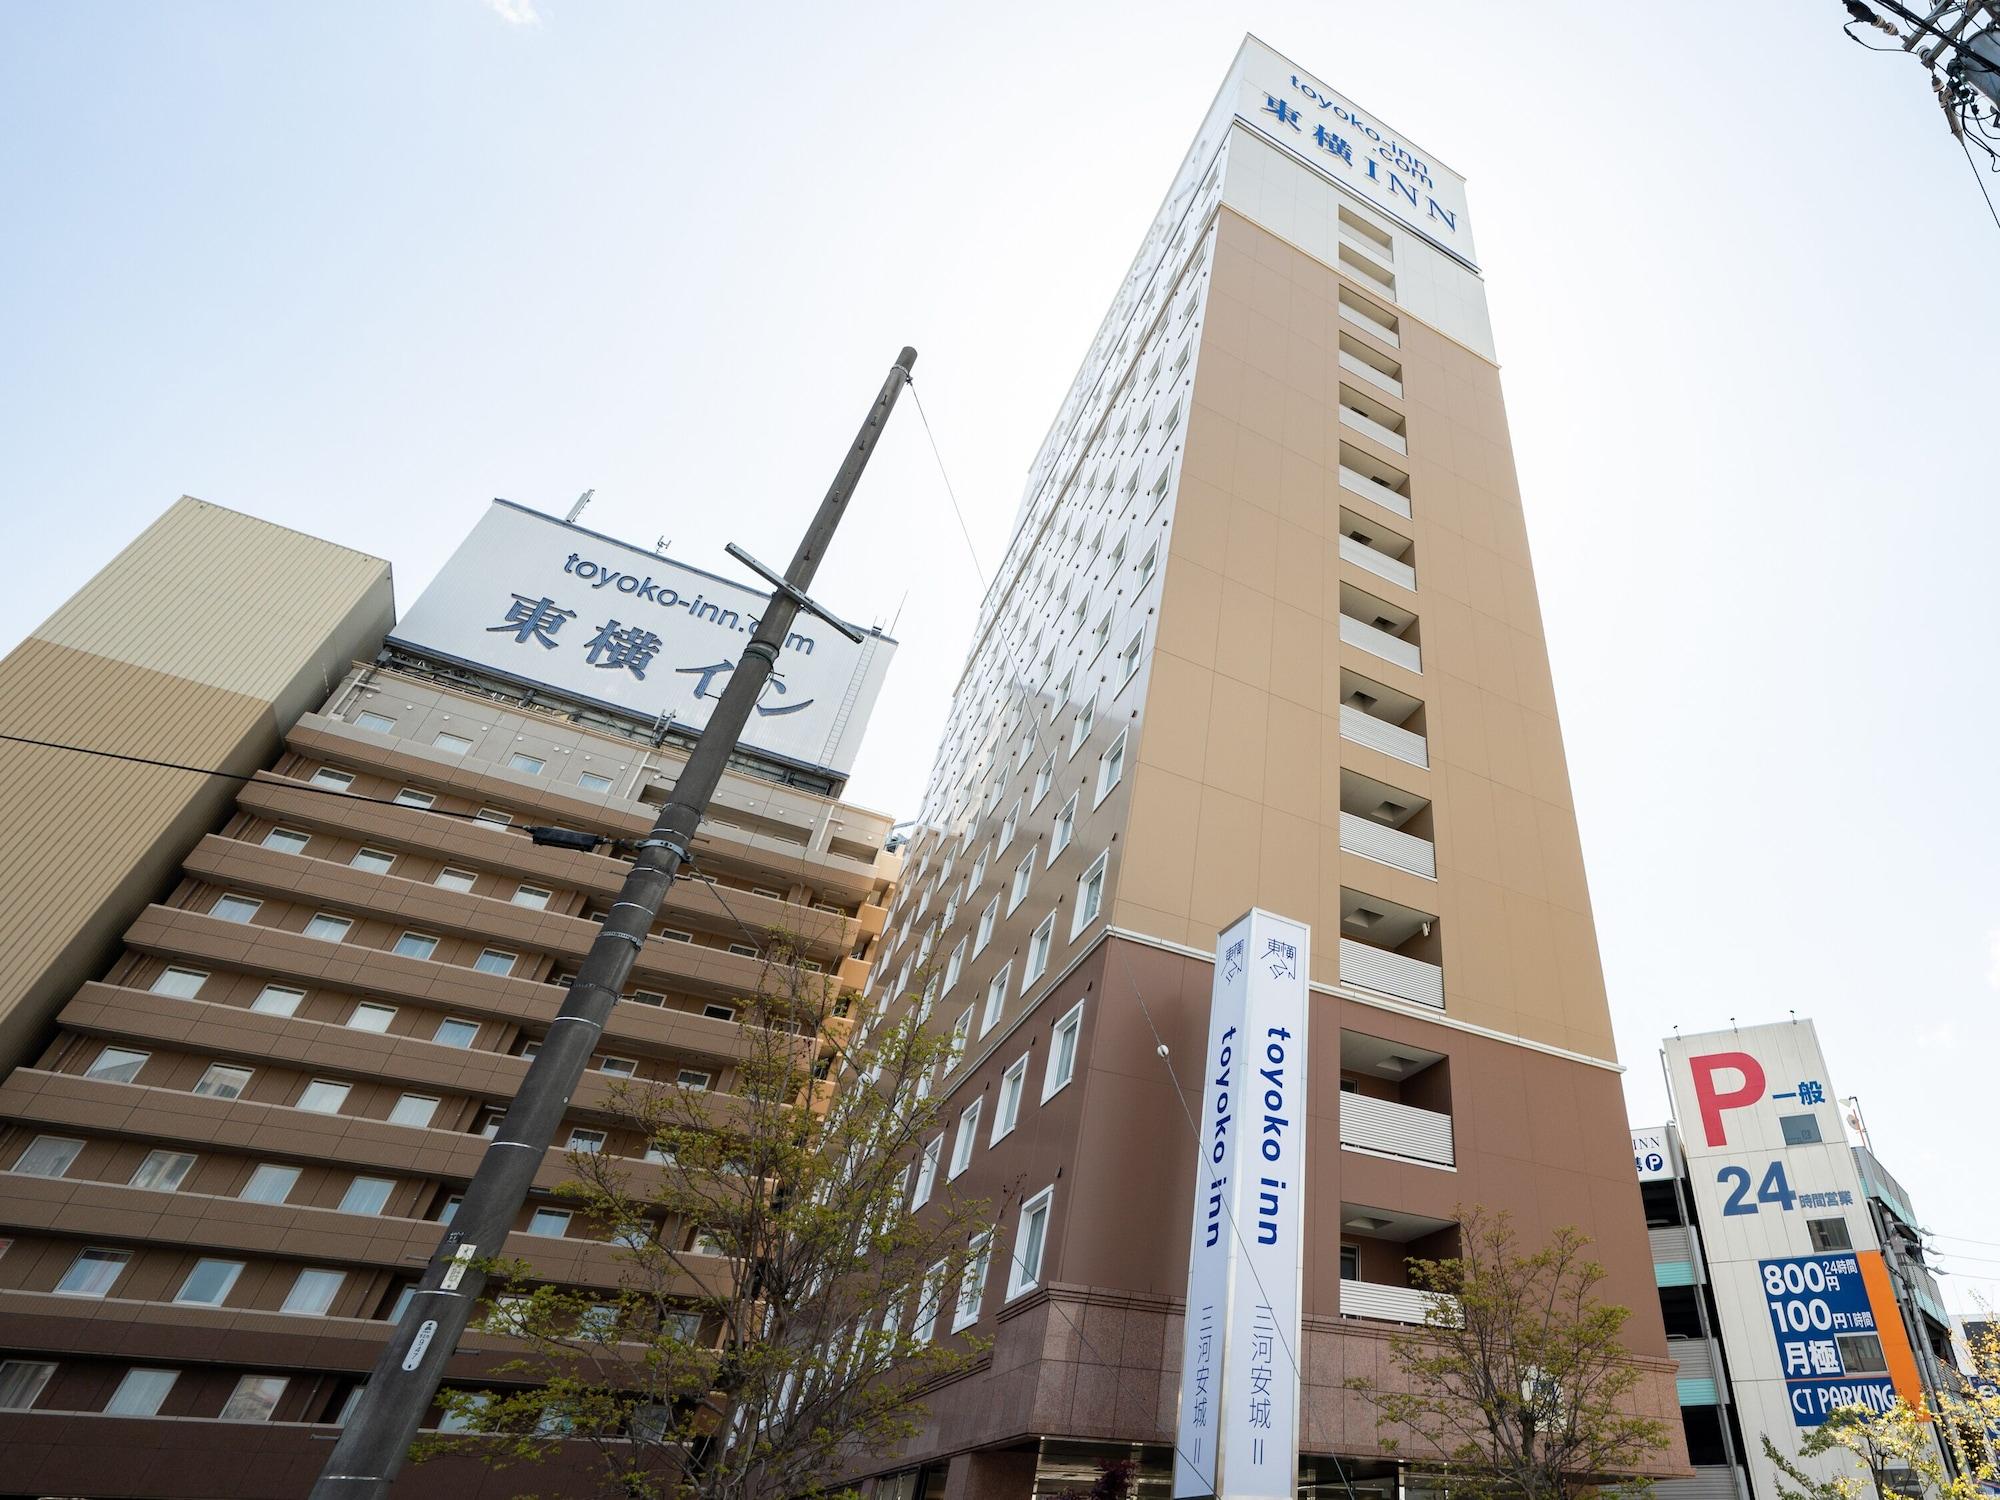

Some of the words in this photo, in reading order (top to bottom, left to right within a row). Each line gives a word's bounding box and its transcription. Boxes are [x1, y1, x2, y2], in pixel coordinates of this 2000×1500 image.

[1290, 75, 1428, 174] toyoko-inn
[563, 552, 815, 656] toyoko-inn.cm
[1213, 1025, 1237, 1164] toyoko
[1259, 1027, 1291, 1162] toyoko
[1689, 1052, 1766, 1147] P
[1772, 1081, 1826, 1105] 一般
[1206, 1177, 1227, 1248] inn
[1258, 1177, 1286, 1245] inn
[1249, 1305, 1274, 1429] 三河安城
[1784, 1340, 1841, 1376] 月極
[1792, 1388, 1815, 1415] CT
[1817, 1384, 1896, 1415] PARKING
